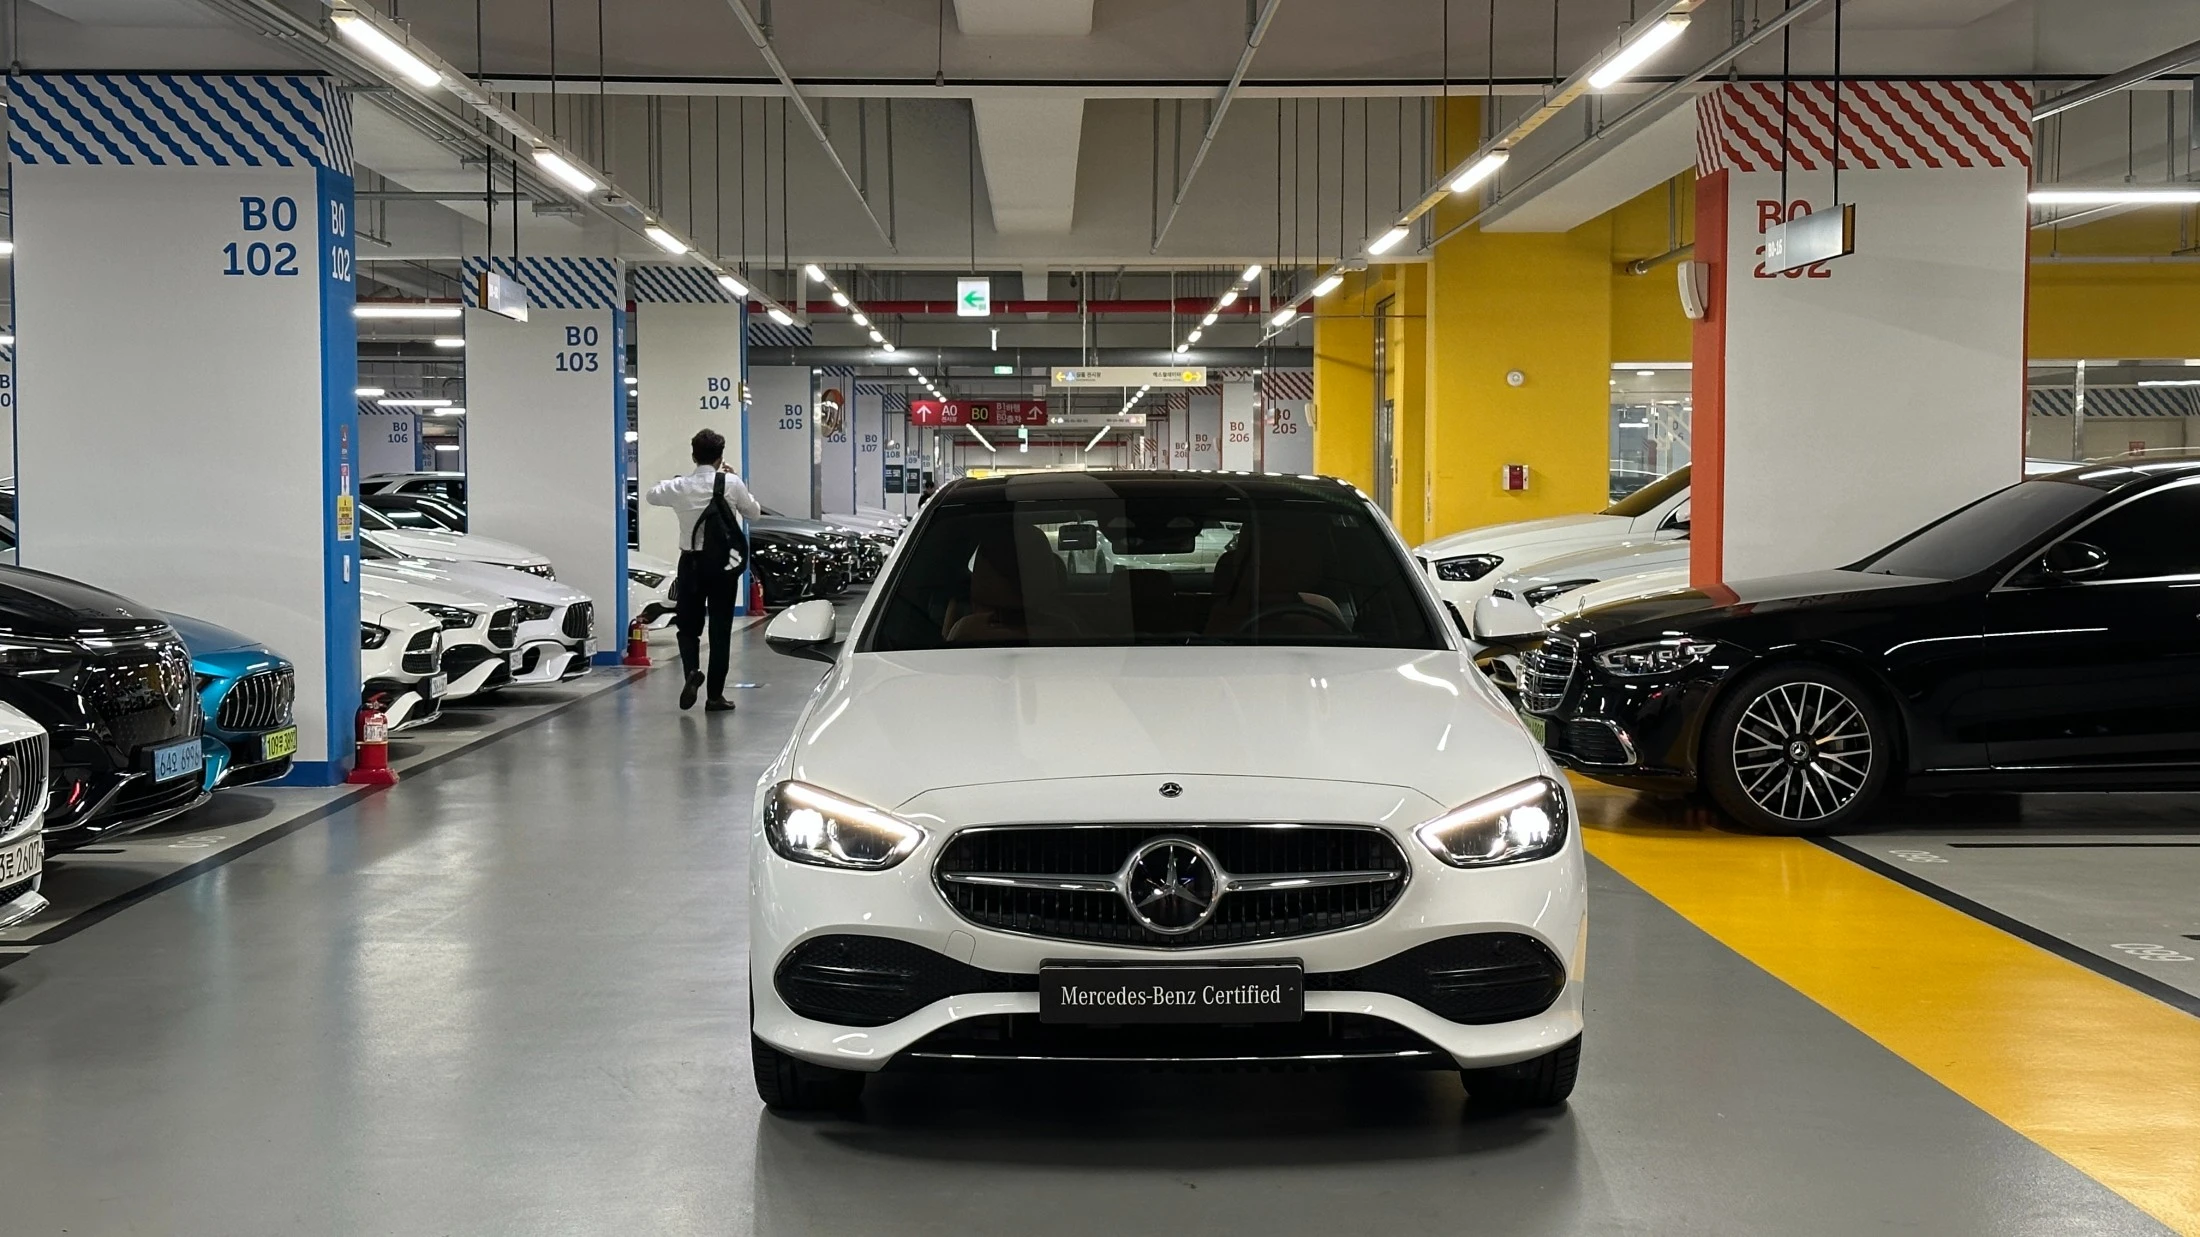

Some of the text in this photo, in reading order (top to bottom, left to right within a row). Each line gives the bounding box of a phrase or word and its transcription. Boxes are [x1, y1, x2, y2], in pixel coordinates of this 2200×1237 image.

[239, 196, 298, 231] B0
[331, 199, 346, 238] B0
[222, 242, 299, 276] 102
[331, 246, 351, 282] 102
[566, 326, 598, 347] B0
[555, 352, 599, 372] 103
[707, 377, 731, 392] B0
[700, 395, 731, 410] 104
[784, 404, 803, 416] B0
[941, 404, 958, 416] A0
[971, 408, 988, 420] B0
[393, 422, 408, 432] B0
[779, 418, 803, 430] 105
[1229, 421, 1245, 431] B0
[1272, 423, 1297, 434] 205
[388, 434, 408, 443] 106
[865, 434, 878, 443] B0
[1195, 434, 1208, 442] B0
[1229, 434, 1250, 442] 206
[861, 444, 878, 452] 107
[1195, 443, 1212, 451] 207
[16, 840, 40, 877] 2607
[1061, 984, 1281, 1006] Mercedes-Benz Certified
